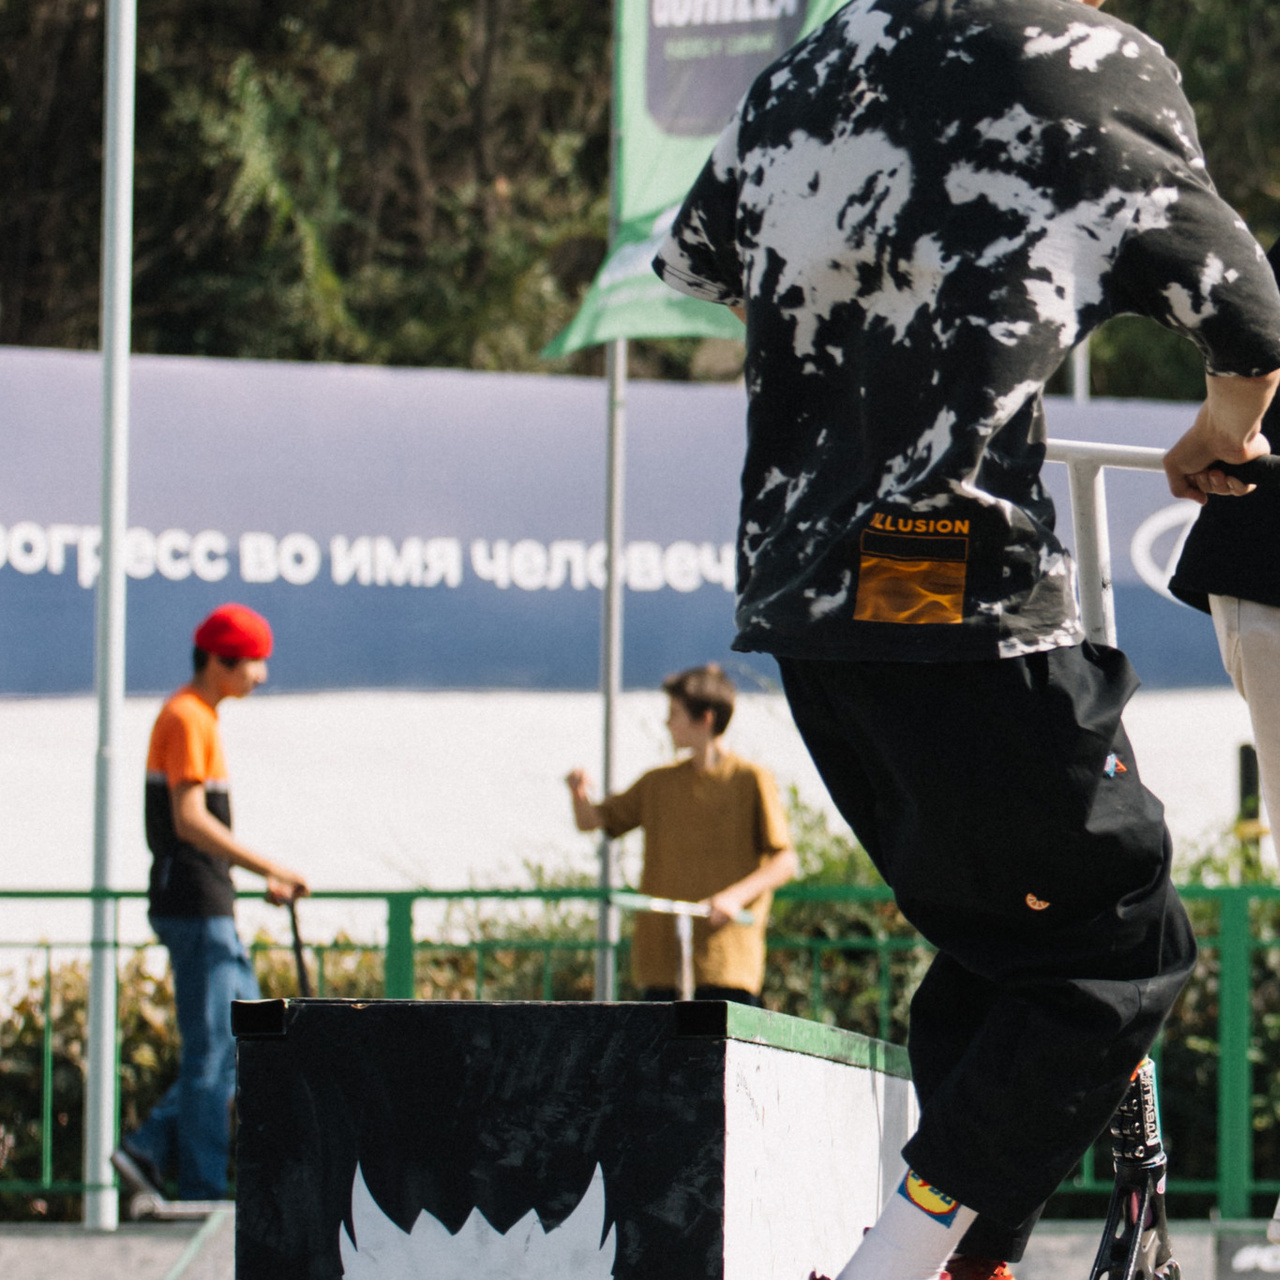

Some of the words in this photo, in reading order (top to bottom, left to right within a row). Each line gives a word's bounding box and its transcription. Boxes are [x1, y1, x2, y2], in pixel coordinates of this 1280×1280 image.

[0, 519, 230, 589] огресс
[238, 530, 322, 587] во
[329, 532, 463, 589] имя
